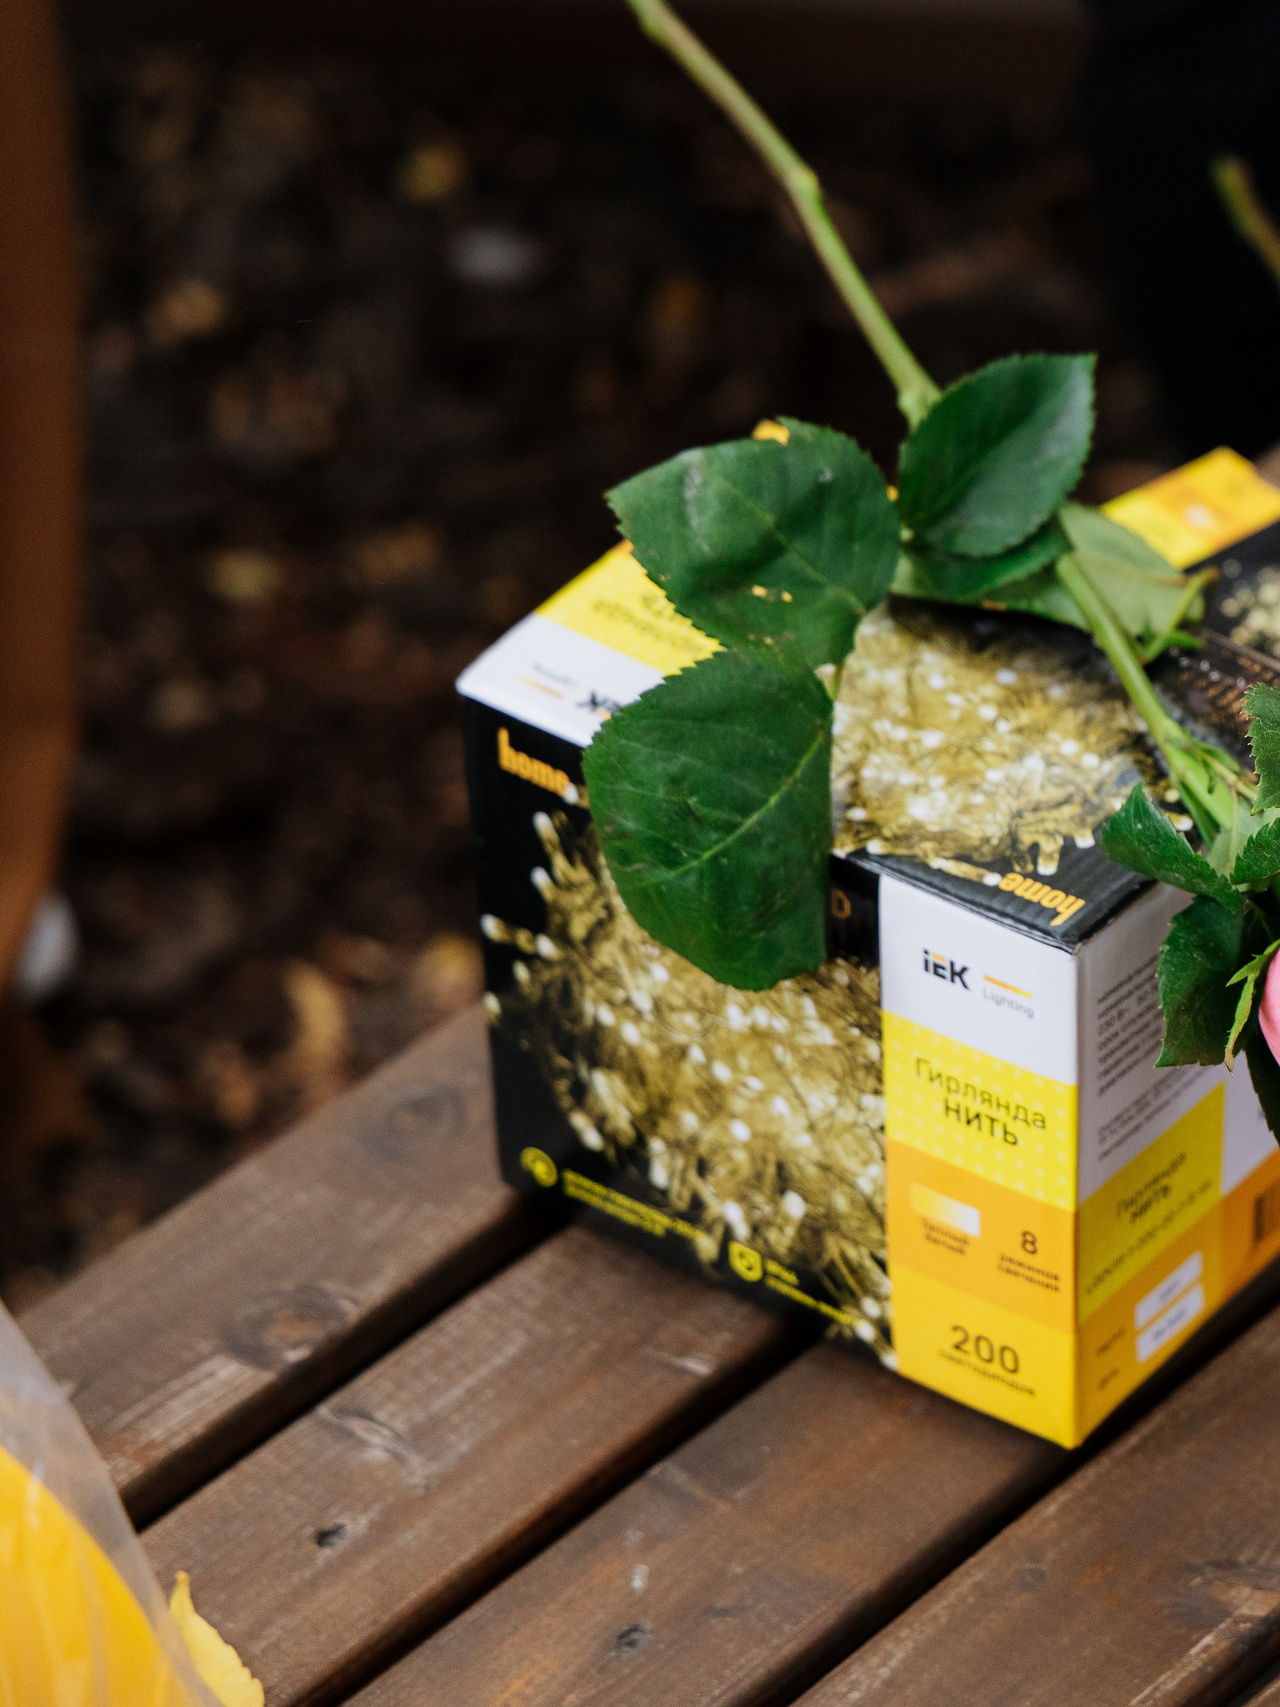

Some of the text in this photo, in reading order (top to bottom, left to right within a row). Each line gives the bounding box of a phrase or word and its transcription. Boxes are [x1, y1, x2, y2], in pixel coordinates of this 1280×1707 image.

[997, 872, 1086, 927] home
[982, 986, 1035, 1019] Lighting
[914, 1057, 1047, 1130] Гирлянда
[1021, 1230, 1038, 1255] 8
[950, 1324, 1020, 1375] 200
